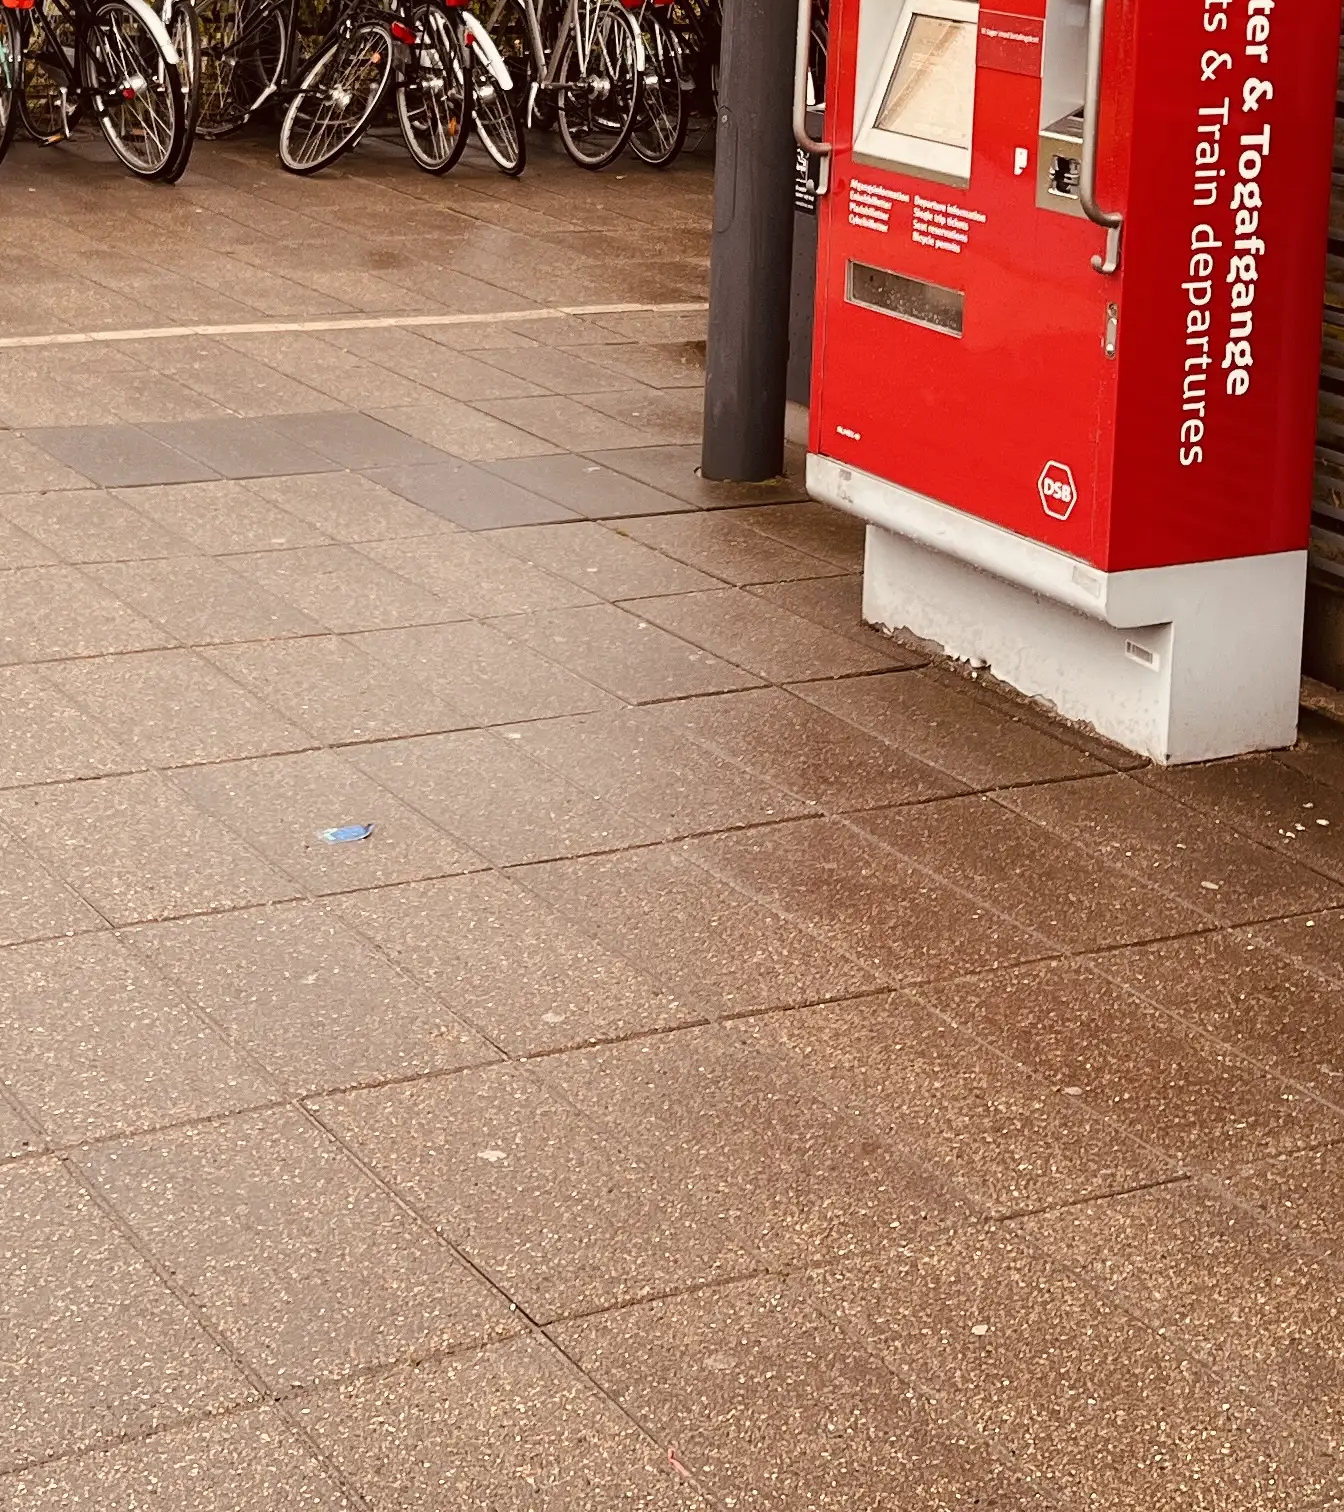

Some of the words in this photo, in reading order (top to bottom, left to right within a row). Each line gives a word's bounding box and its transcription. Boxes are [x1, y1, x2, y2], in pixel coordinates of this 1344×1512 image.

[1200, 49, 1233, 81] &
[1242, 77, 1274, 112] &
[1192, 97, 1230, 206] Train
[1221, 124, 1271, 396] Togafgange
[1179, 223, 1223, 466] departures
[1043, 477, 1072, 503] DSB
